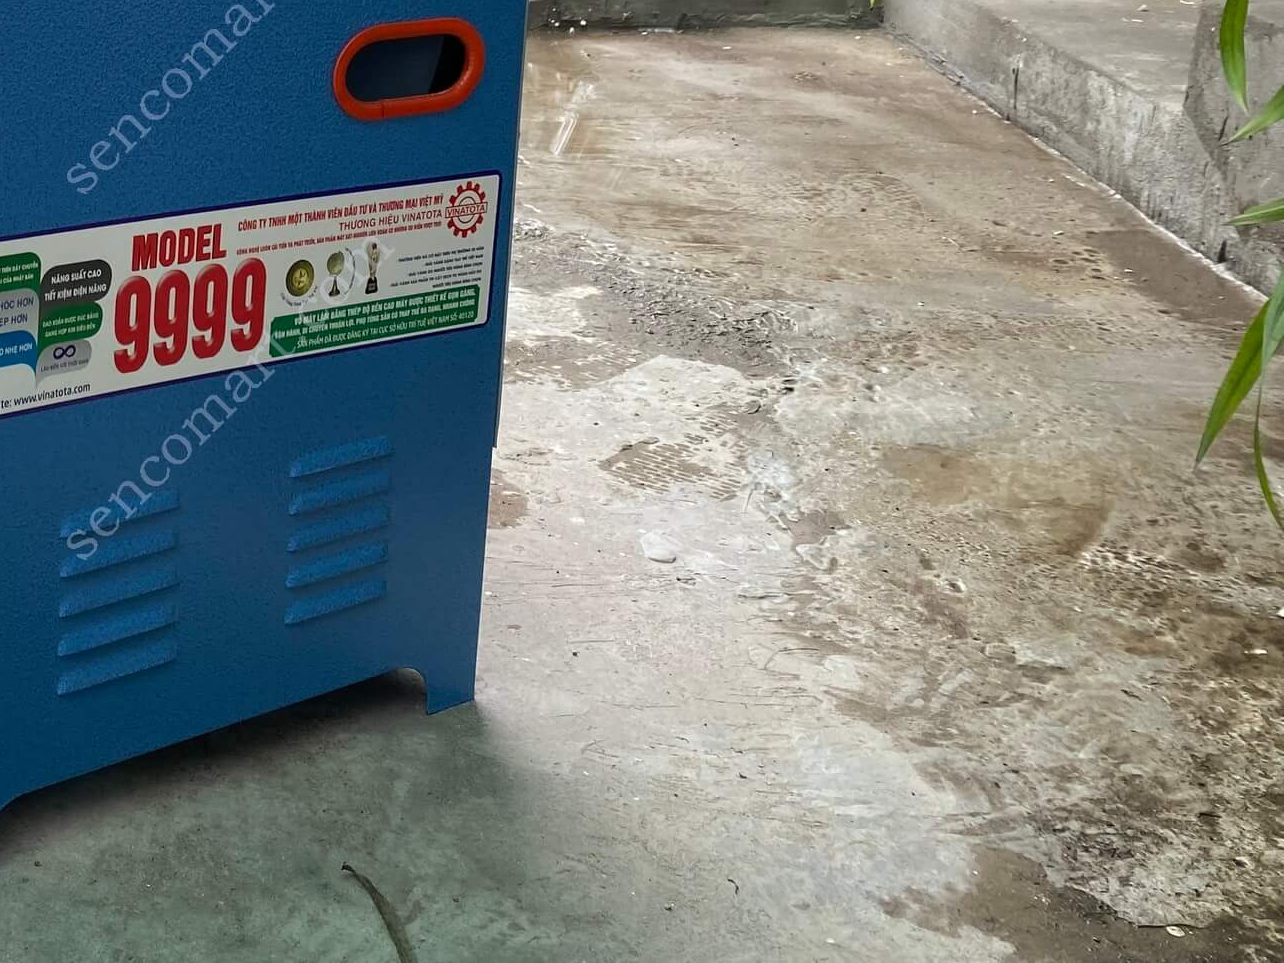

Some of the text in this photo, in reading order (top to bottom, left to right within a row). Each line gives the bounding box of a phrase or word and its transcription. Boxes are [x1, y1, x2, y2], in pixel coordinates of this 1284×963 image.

[238, 218, 256, 230] CÔNG
[259, 218, 266, 228] TY
[268, 216, 286, 226] TNHH
[287, 212, 302, 226] MỘT
[304, 209, 325, 221] THÀNH
[327, 206, 342, 218] VIÊN
[344, 203, 357, 216] ĐẦU
[359, 203, 368, 214] TƯ
[368, 201, 376, 213] VÀ
[379, 199, 403, 211] THƯƠNG
[405, 198, 417, 209] MẠI
[419, 195, 432, 207] VIỆT
[339, 217, 375, 230] THƯƠNG
[379, 213, 398, 226] HIỆU
[402, 209, 441, 222] VINATOTA
[447, 204, 486, 216] VINATOTA
[132, 223, 227, 271] MODEL
[71, 268, 85, 280] SUẤT
[87, 269, 101, 277] CAO
[44, 289, 56, 300] TIẾT
[57, 287, 71, 301] KIỆM
[73, 284, 87, 297] ĐIỆN
[113, 257, 267, 374] 9999
[371, 301, 382, 311] BỀN
[11, 313, 27, 324] HƠN
[14, 382, 91, 406] www.vinatota.com
